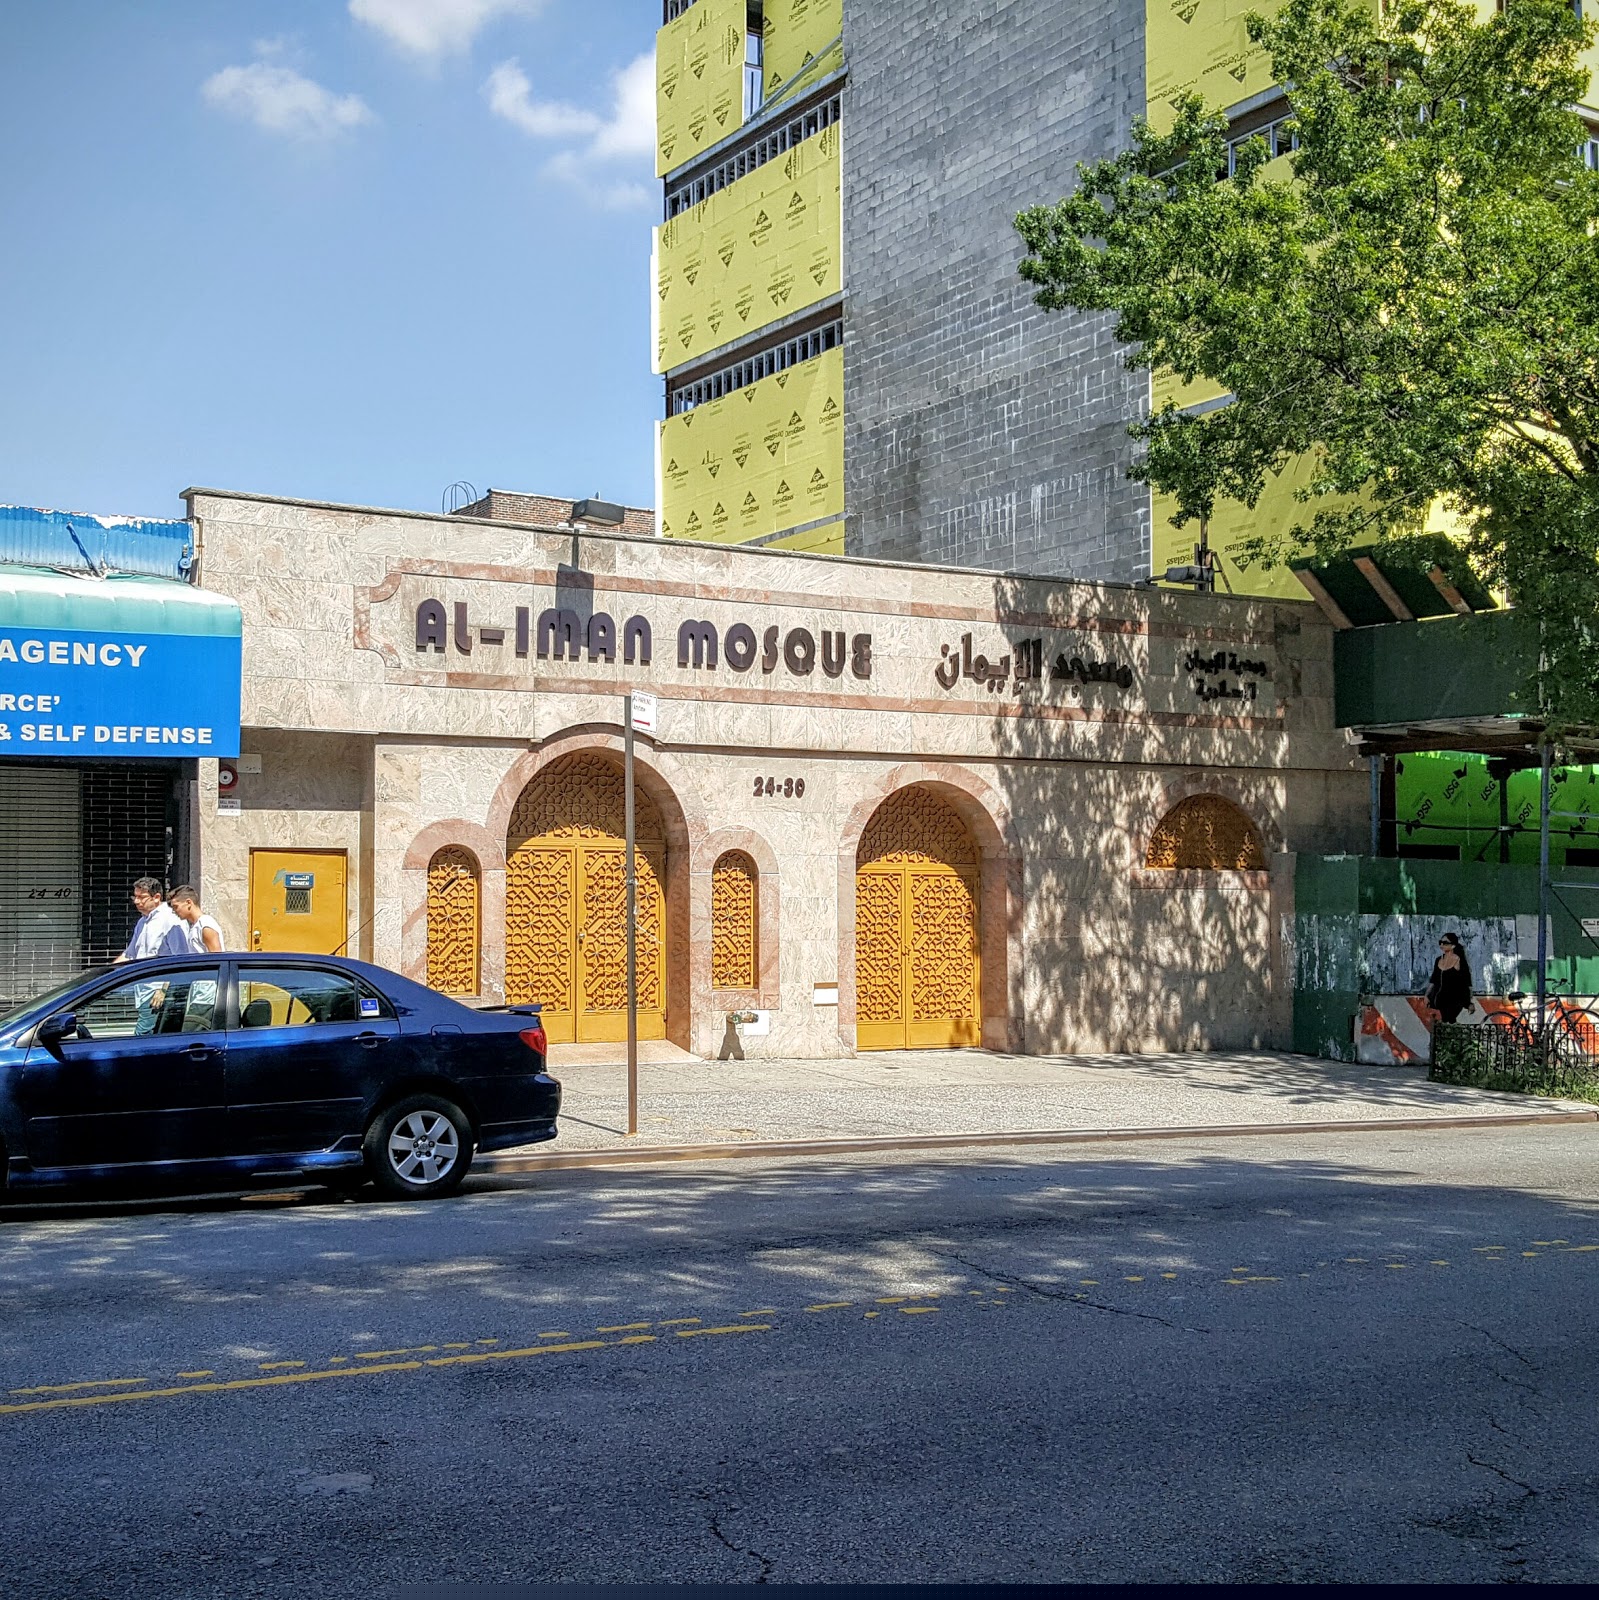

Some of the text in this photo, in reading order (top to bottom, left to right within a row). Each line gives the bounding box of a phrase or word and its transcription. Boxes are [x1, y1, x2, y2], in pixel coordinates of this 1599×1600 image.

[807, 483, 829, 494] DensGlass
[772, 495, 794, 506] DensGlass
[1166, 555, 1194, 565] ensGlass
[0, 639, 147, 667] AGENCY
[677, 619, 872, 680] MOSQUE
[0, 724, 213, 744] & SELF DEFENSE
[753, 776, 805, 798] 24-30
[1443, 779, 1459, 799] USG
[1481, 781, 1496, 801] USG
[1416, 799, 1433, 819] USG
[1519, 803, 1534, 823] USG
[28, 888, 71, 899] 24 40
